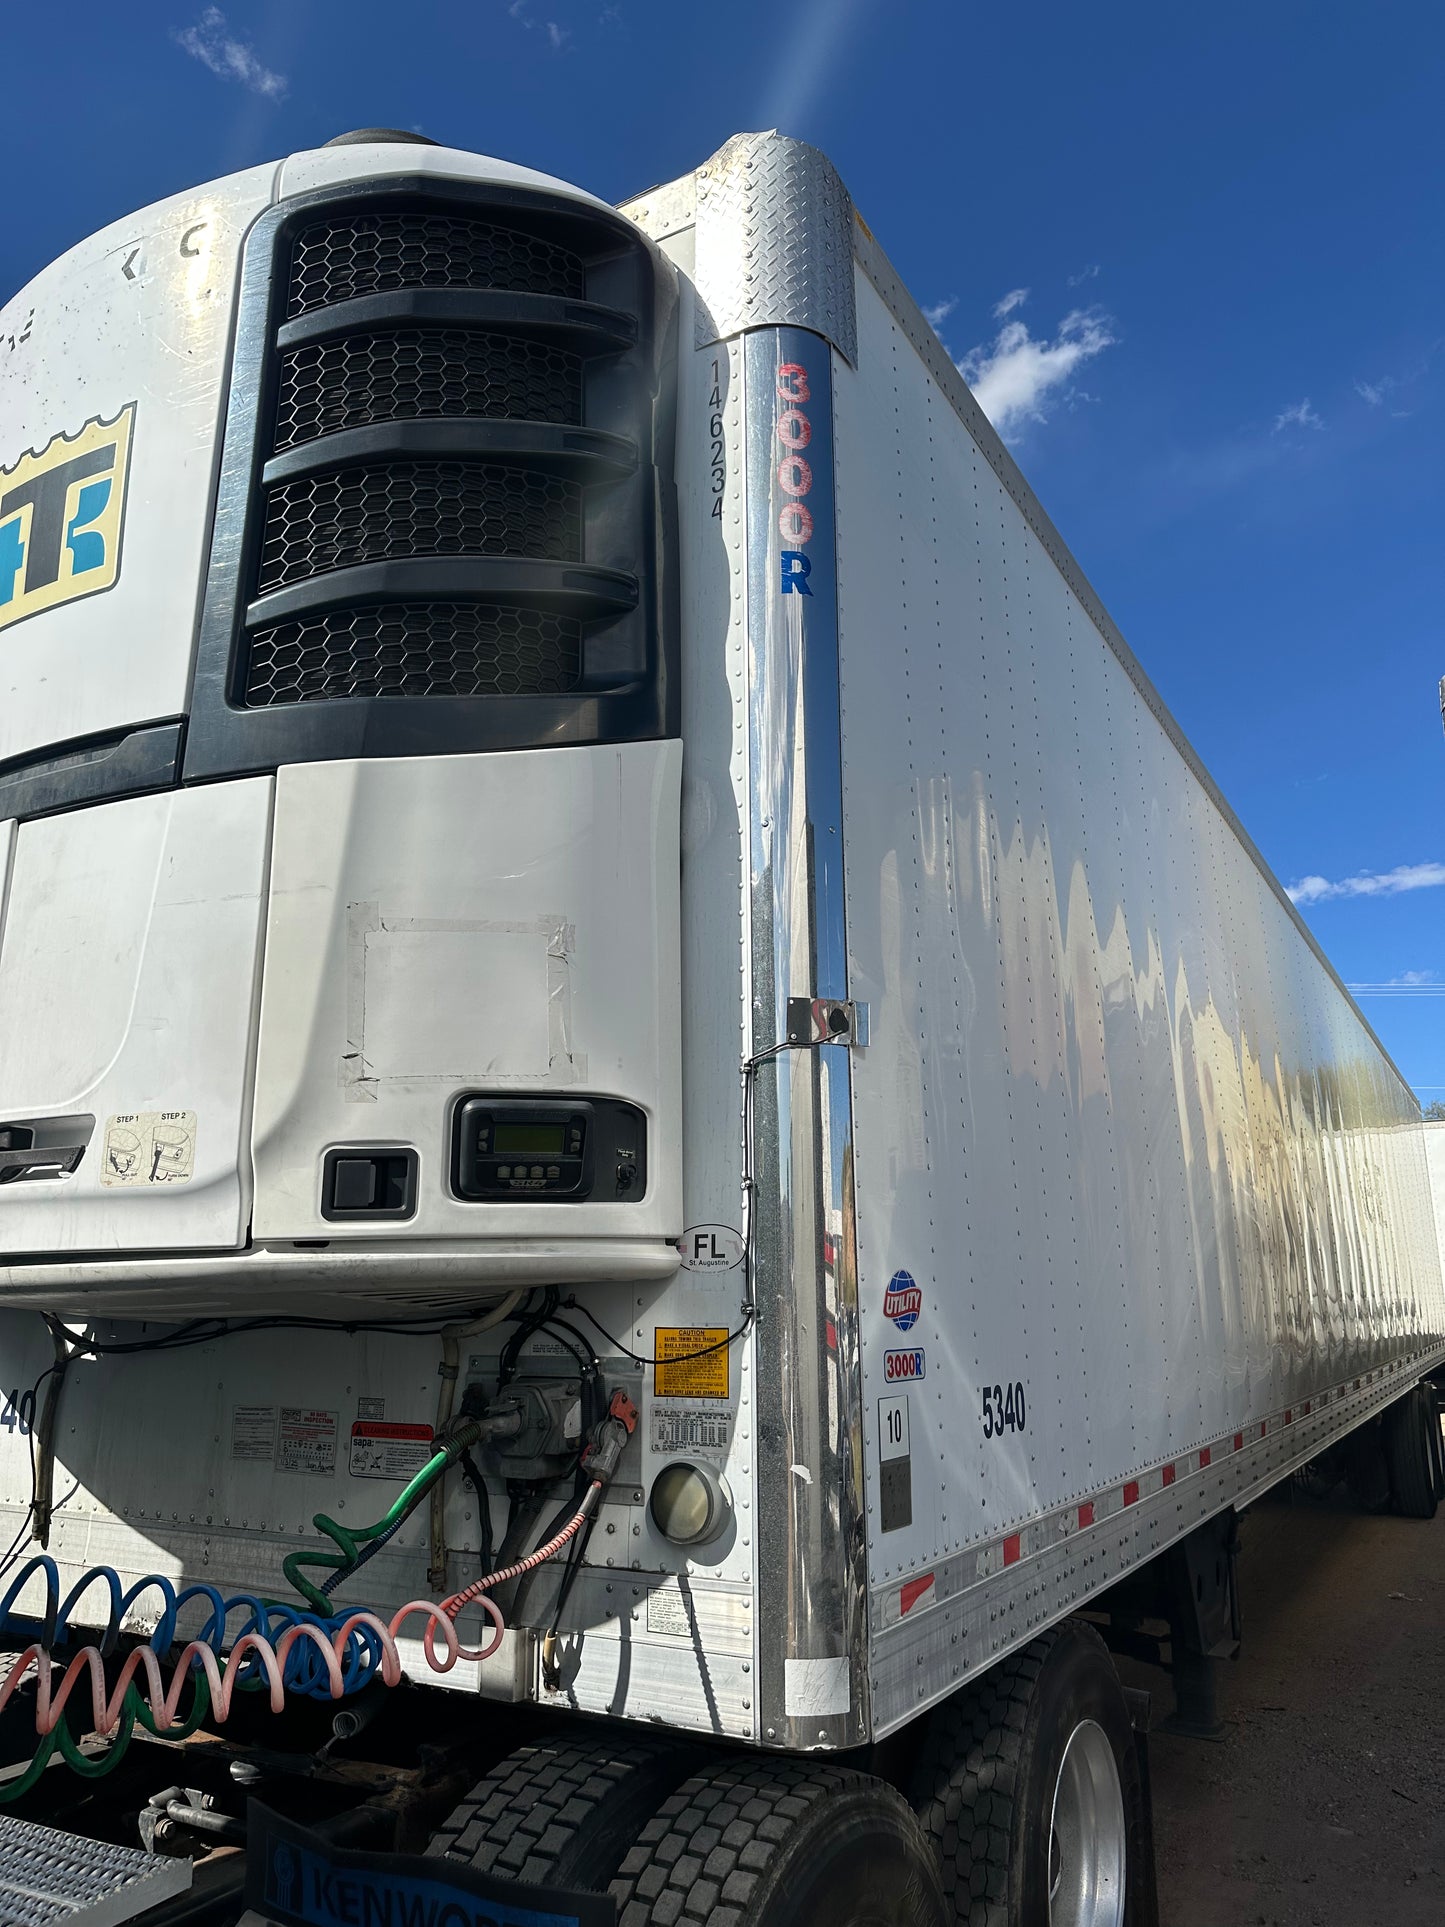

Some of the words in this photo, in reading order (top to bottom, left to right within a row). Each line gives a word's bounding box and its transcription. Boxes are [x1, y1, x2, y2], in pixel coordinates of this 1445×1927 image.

[708, 359, 726, 521] 146234
[776, 362, 815, 597] 3000R
[116, 1115, 134, 1123] STEP
[161, 1112, 180, 1120] STEP
[694, 1233, 726, 1259] FL
[698, 1259, 730, 1268] Augustine
[886, 1291, 920, 1315] UTILITY
[886, 1352, 923, 1379] 3000R
[303, 1416, 334, 1425] INSPECTION
[982, 1381, 1026, 1439] 5340
[886, 1409, 902, 1444] 10
[353, 1438, 375, 1449] sapa:
